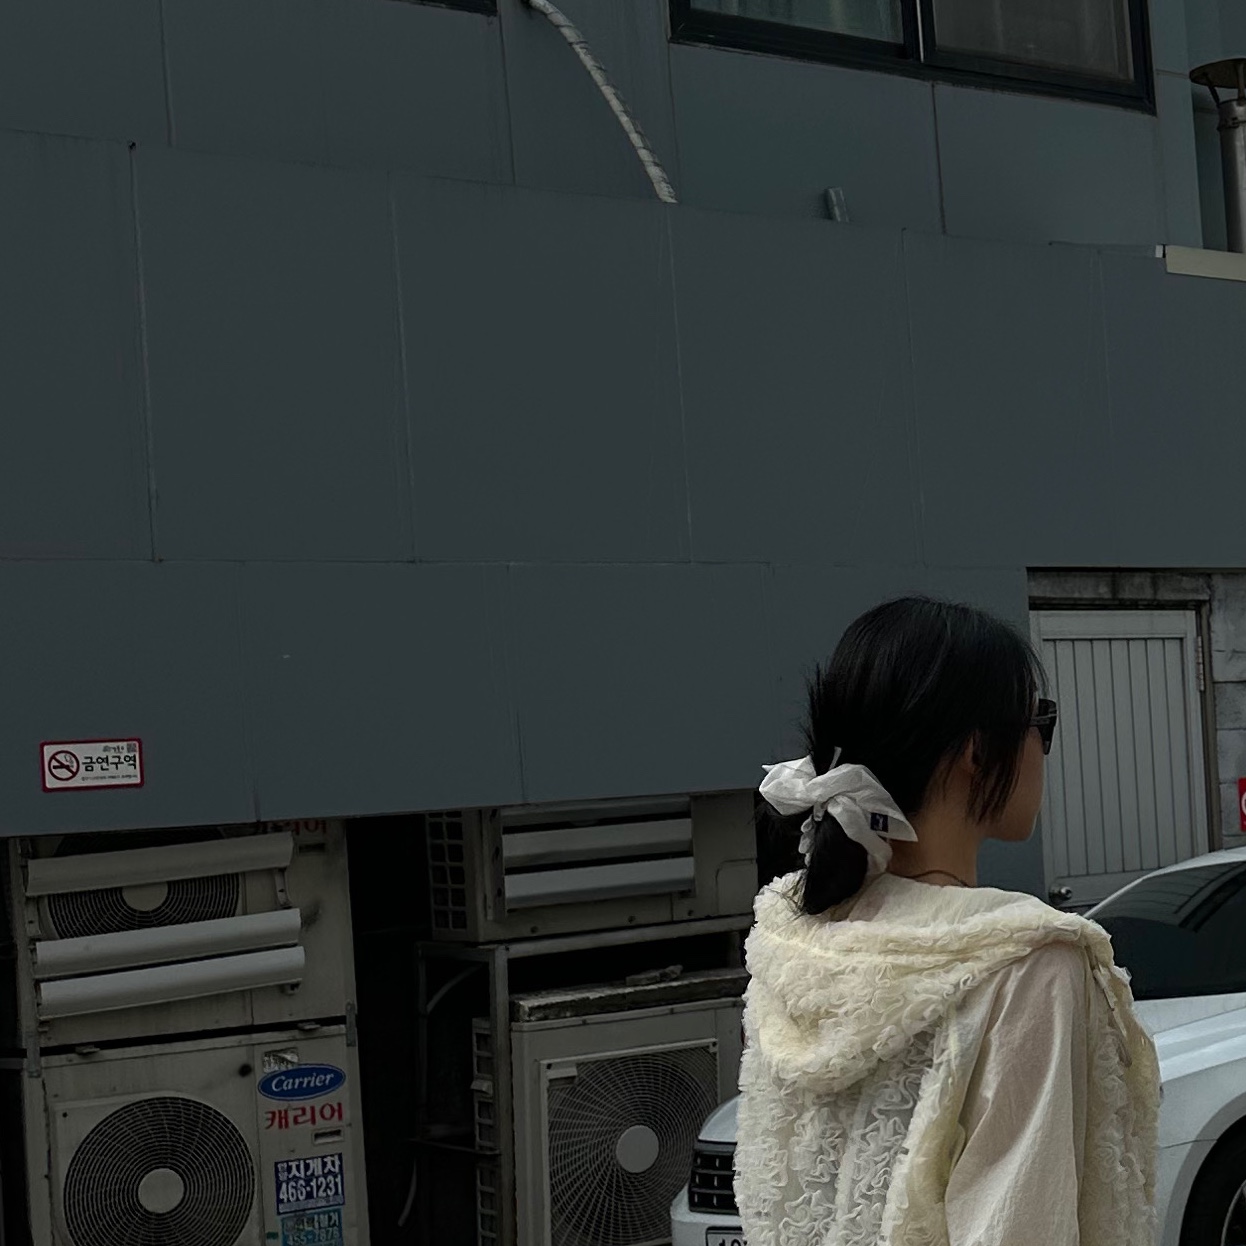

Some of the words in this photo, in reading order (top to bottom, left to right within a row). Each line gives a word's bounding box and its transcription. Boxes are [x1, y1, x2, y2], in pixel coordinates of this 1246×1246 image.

[82, 754, 137, 772] 금연구역
[271, 1072, 334, 1093] Carrier
[264, 1102, 343, 1130] 캐리어
[288, 1154, 341, 1180] 지게차
